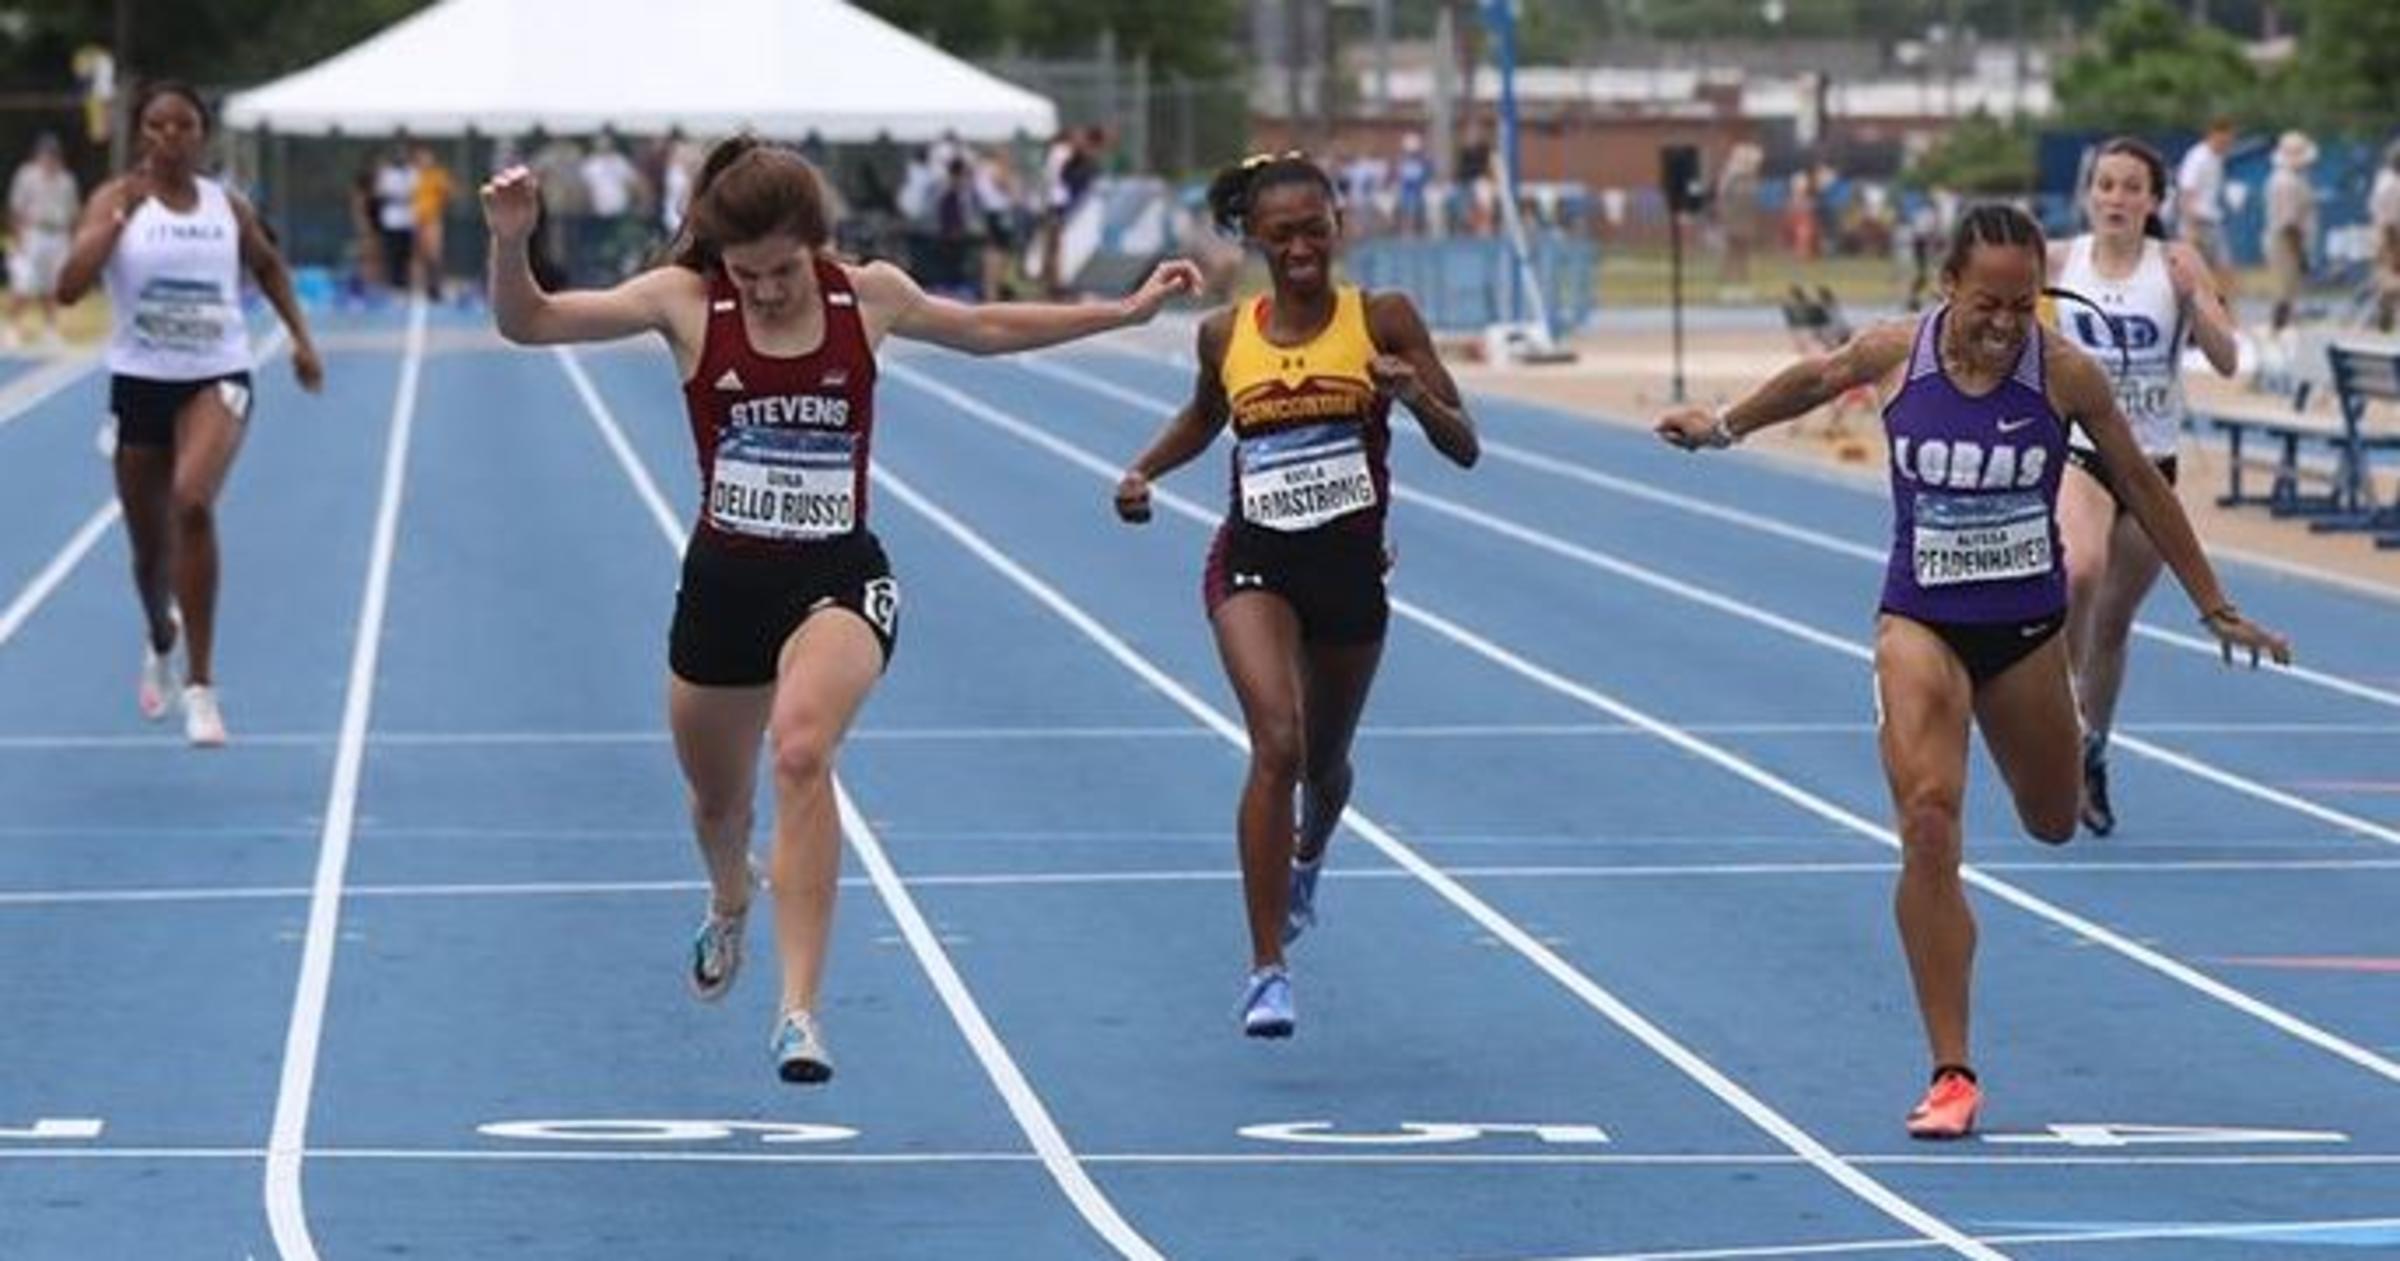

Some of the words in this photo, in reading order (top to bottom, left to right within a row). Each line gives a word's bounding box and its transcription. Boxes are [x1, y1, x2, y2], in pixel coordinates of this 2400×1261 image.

[731, 396, 850, 428] STEVENS
[1895, 437, 2047, 490] LORAS
[714, 481, 777, 521] DELLO
[780, 490, 851, 528] RUSSO
[1247, 473, 1371, 519] ARMSTRONG
[1917, 536, 2047, 578] PFADENHAUER
